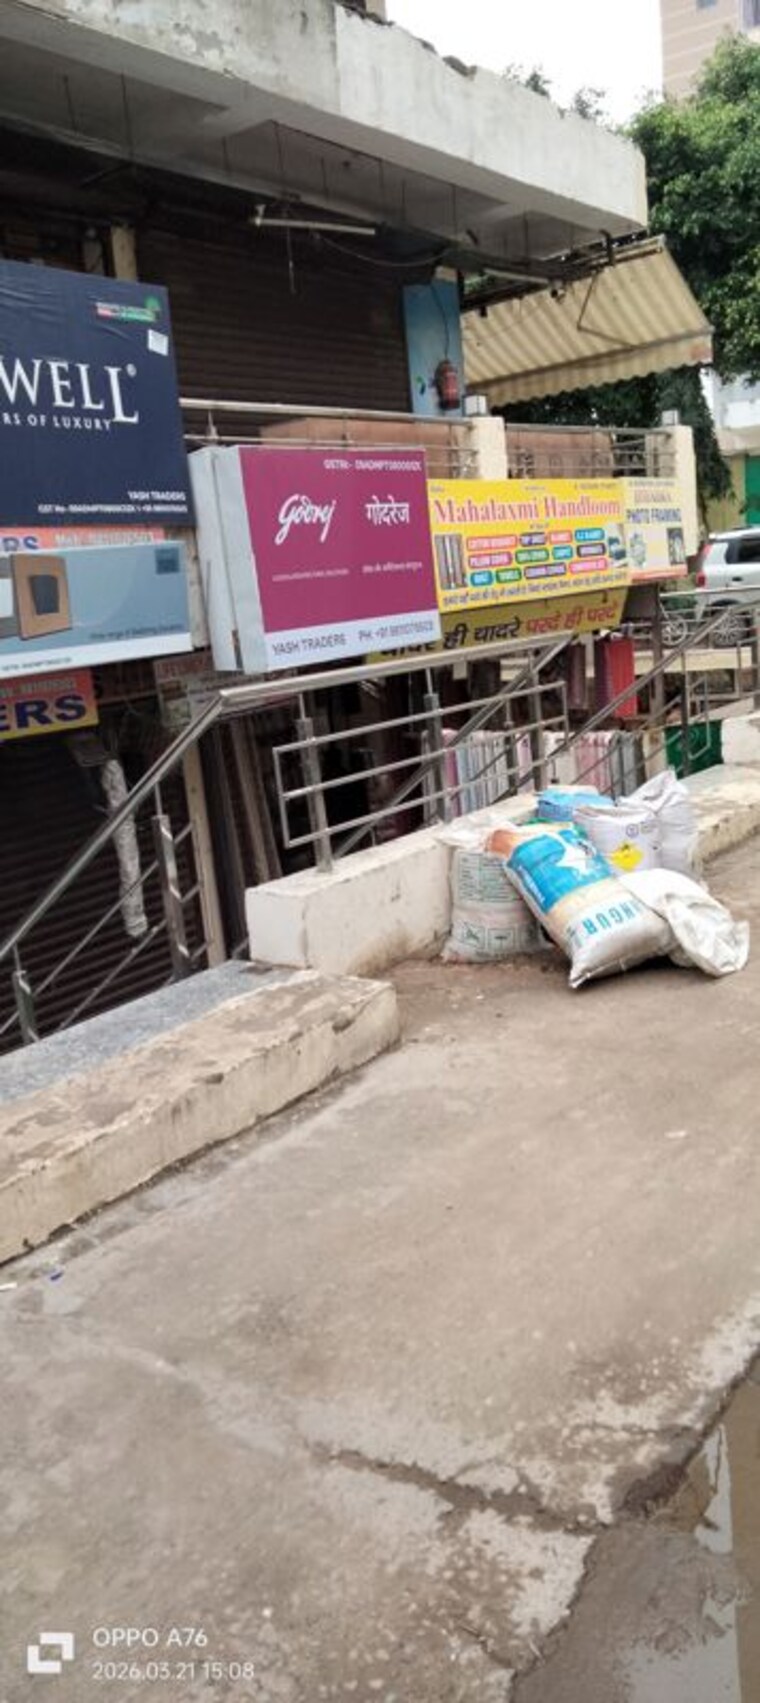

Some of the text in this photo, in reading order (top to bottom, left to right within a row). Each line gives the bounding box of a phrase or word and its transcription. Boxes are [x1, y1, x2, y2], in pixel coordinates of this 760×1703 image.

[27, 414, 47, 428] OF
[53, 415, 112, 432] LUXURY
[150, 491, 187, 502] TRADERS
[275, 494, 337, 546] Godrej
[365, 495, 410, 526] गोदरेज
[434, 496, 540, 525] Mahalaxmi
[544, 496, 621, 518] Handloom
[272, 637, 300, 657] YASH
[302, 633, 347, 652] TRADERS
[442, 624, 469, 648] ही
